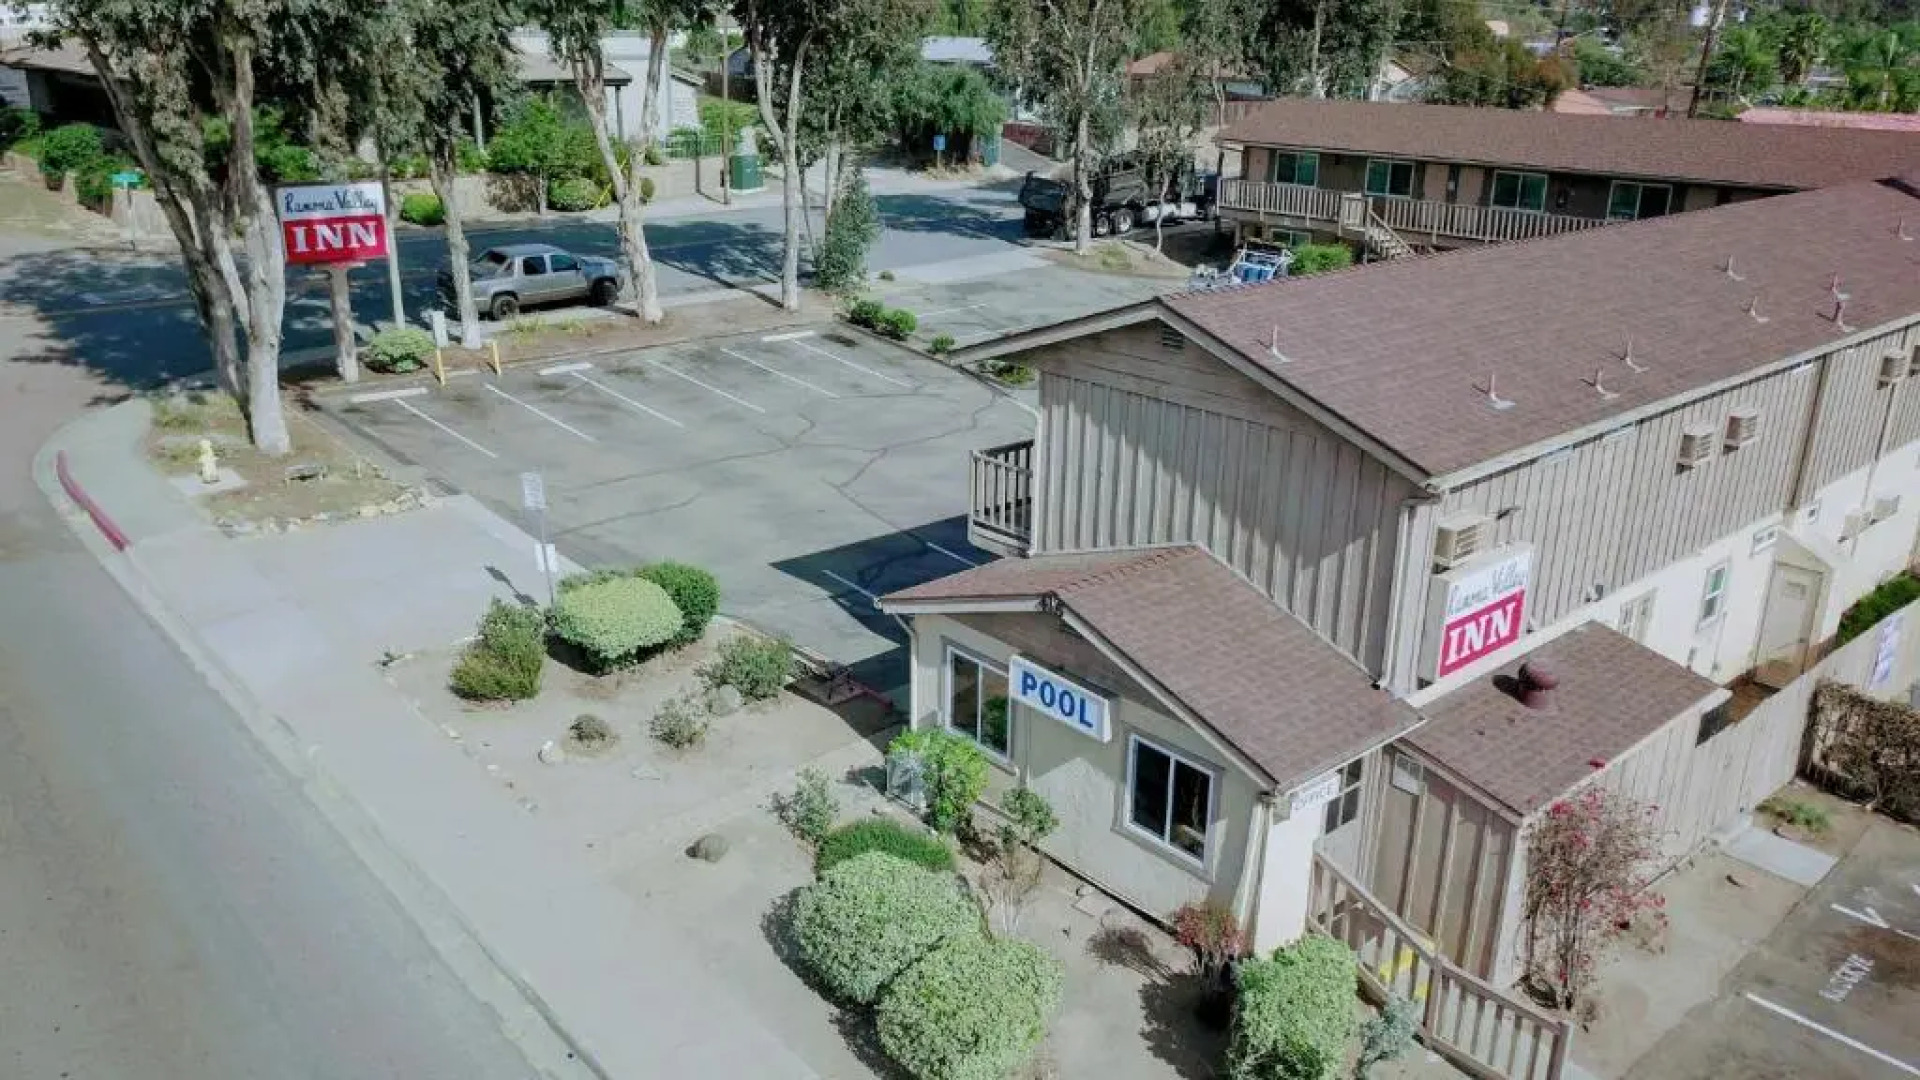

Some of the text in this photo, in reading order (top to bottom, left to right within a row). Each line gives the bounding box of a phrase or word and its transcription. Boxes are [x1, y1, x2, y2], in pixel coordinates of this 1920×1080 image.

[291, 221, 378, 253] INN
[1444, 602, 1517, 667] INN
[1021, 671, 1094, 729] POOL
